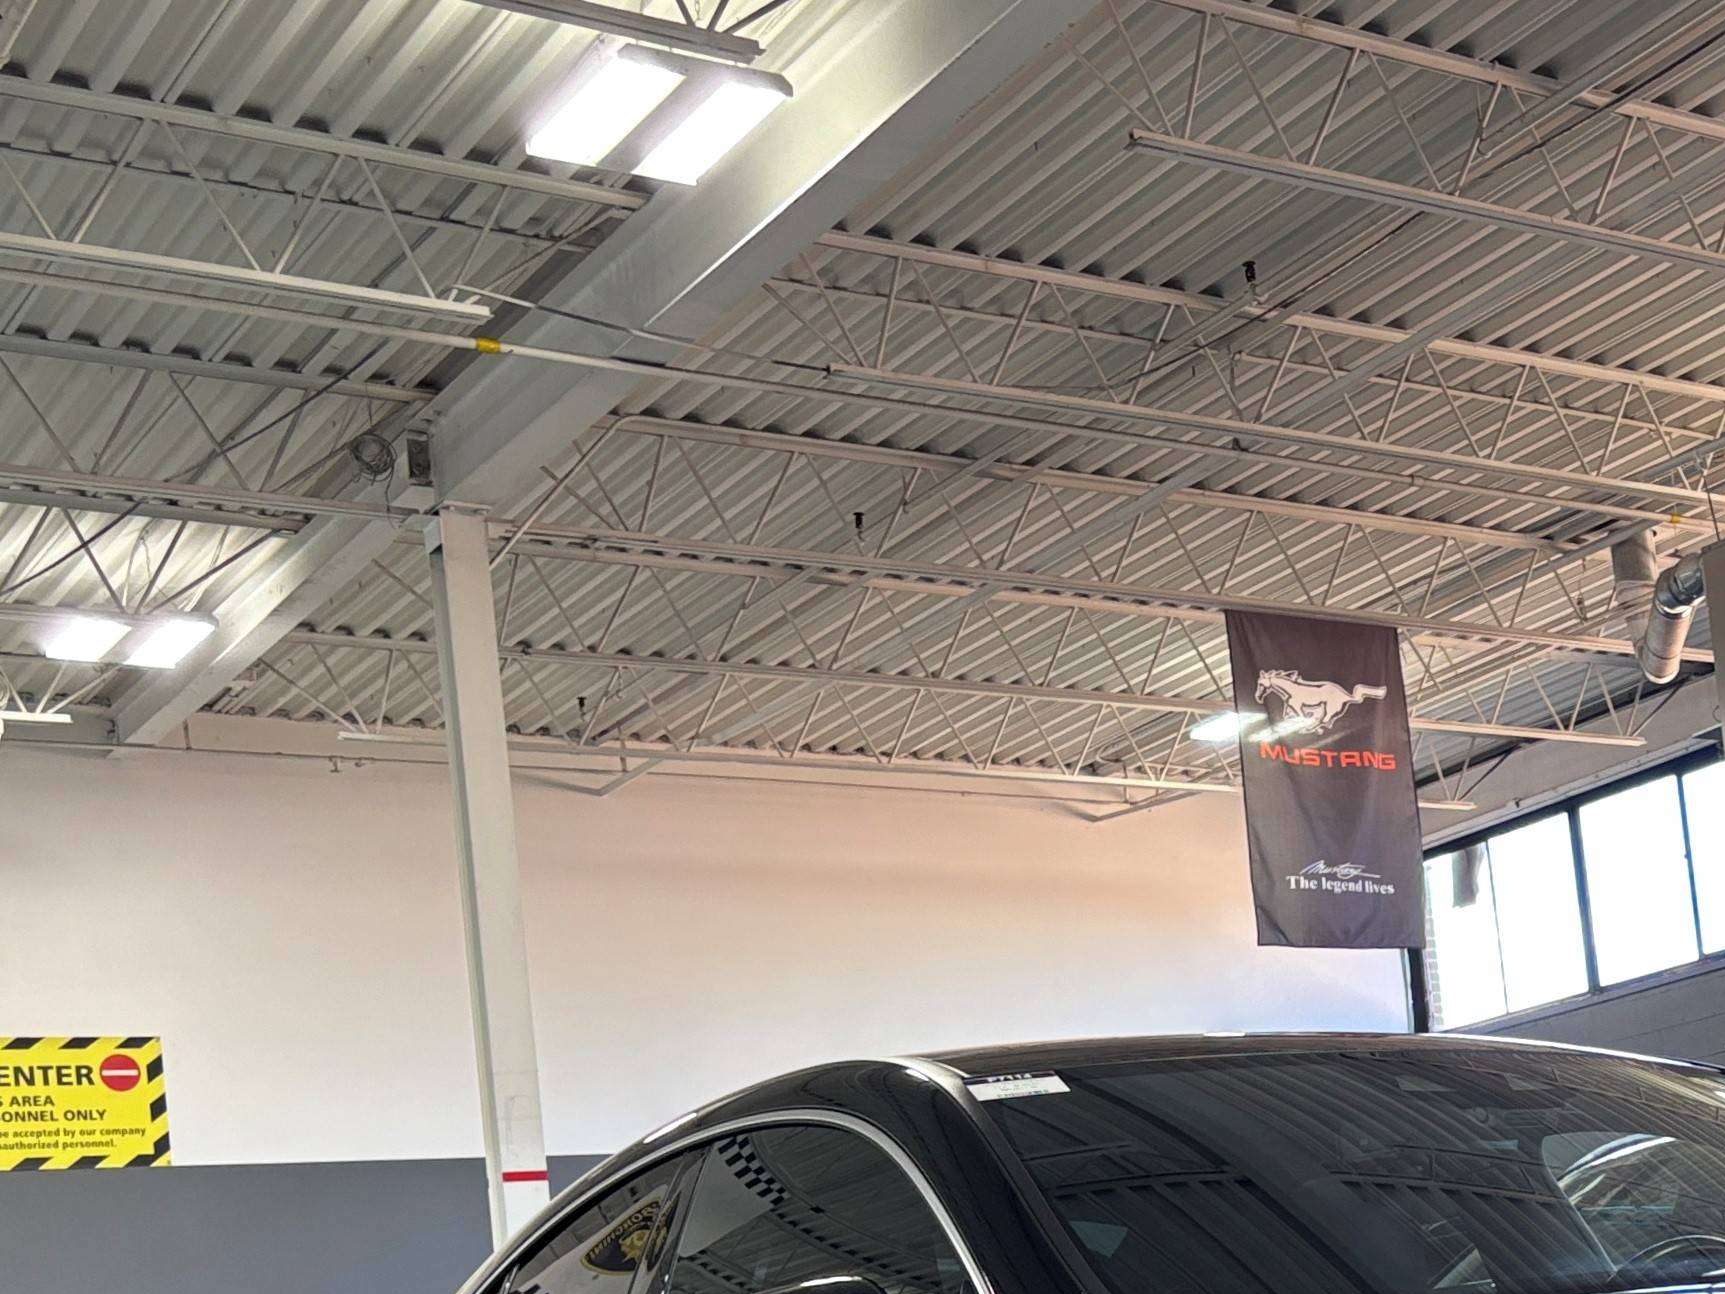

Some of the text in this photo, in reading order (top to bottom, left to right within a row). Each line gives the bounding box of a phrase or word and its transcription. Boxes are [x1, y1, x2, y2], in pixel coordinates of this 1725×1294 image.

[1260, 741, 1397, 770] MUSTANG
[1286, 876, 1395, 894] The legend lives
[0, 1065, 95, 1087] ENTER
[10, 1095, 55, 1107] AREA
[63, 1109, 107, 1121] ONLY
[12, 1128, 61, 1138] accepted
[63, 1128, 76, 1138] by
[79, 1128, 97, 1136] our
[100, 1127, 146, 1136] company
